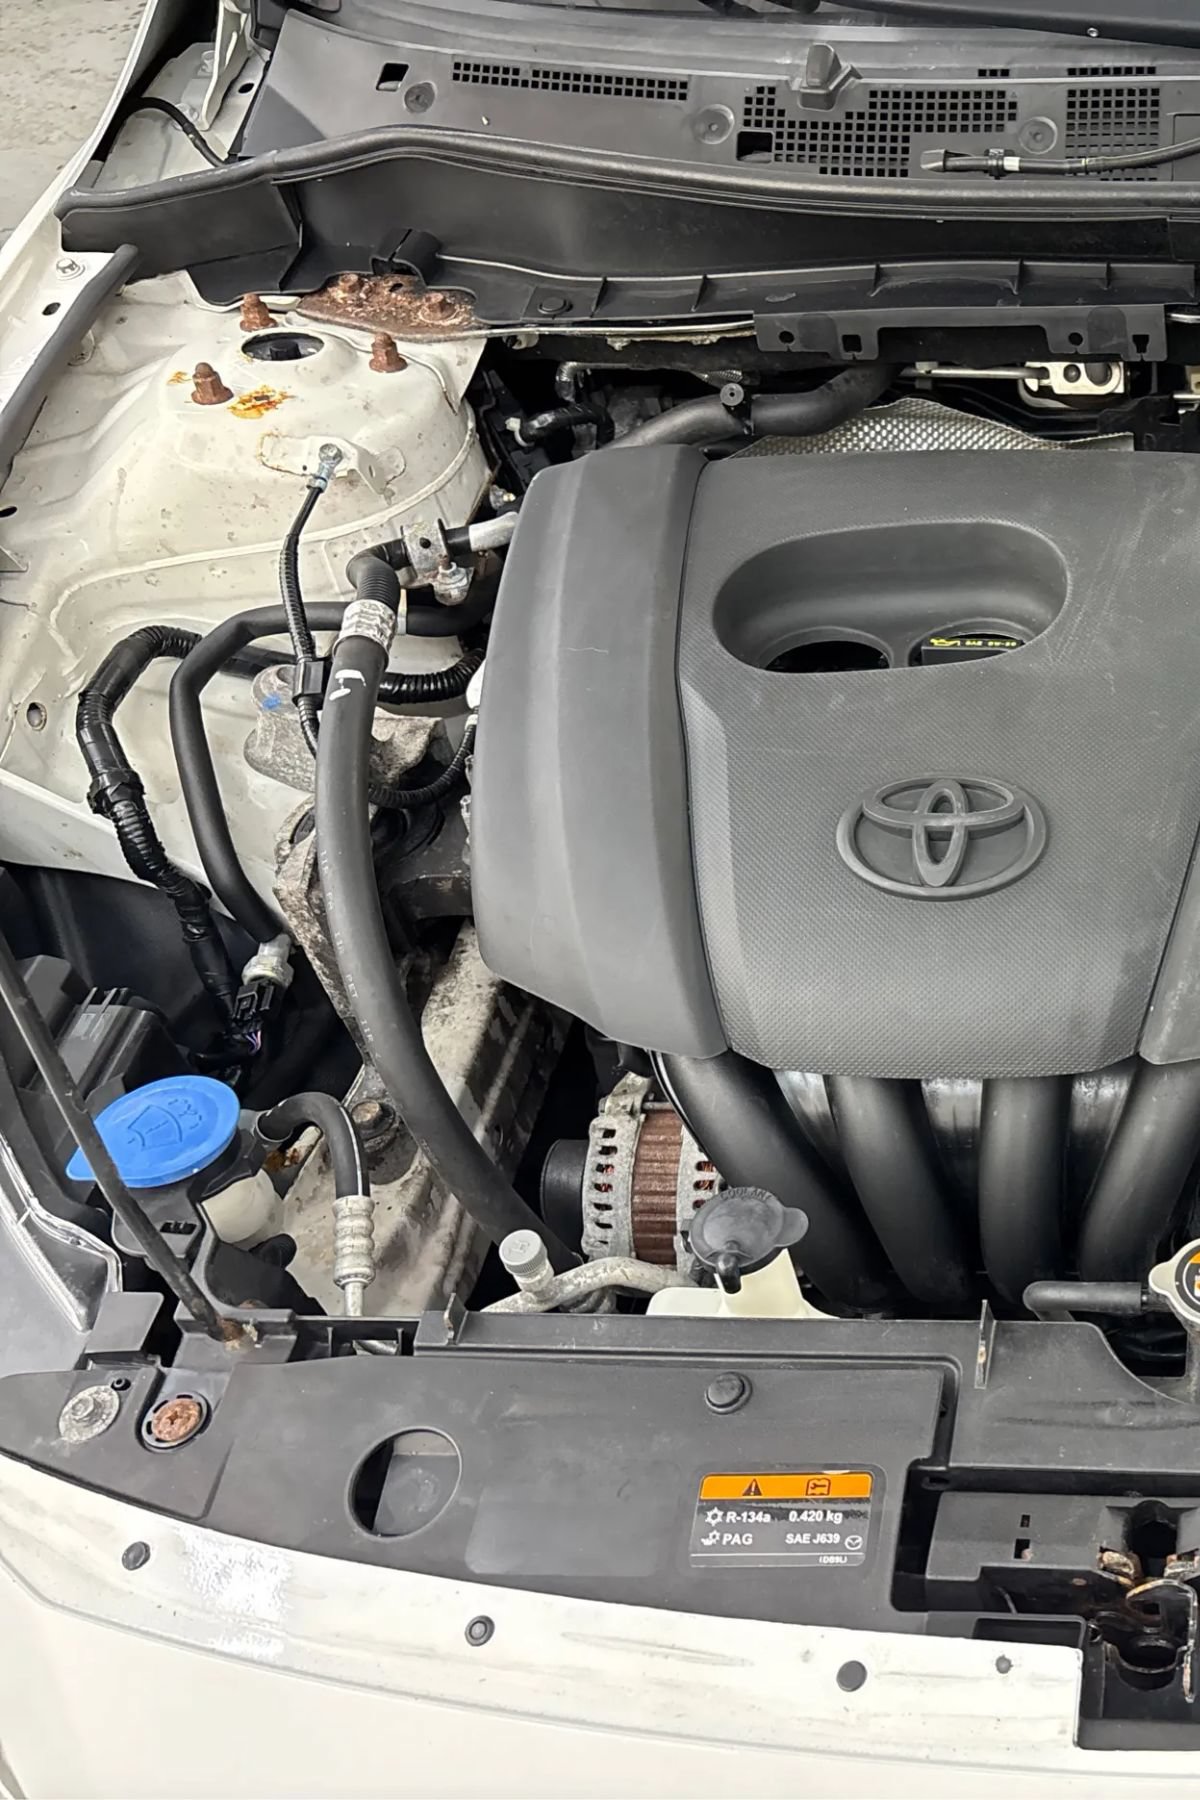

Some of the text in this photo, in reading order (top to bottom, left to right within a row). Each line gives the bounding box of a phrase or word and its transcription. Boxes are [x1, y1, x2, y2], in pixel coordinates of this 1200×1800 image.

[720, 1186, 774, 1200] COOLANT
[726, 1510, 843, 1524] R-134a 0.420 kg
[722, 1532, 840, 1546] PAG SAE J639
